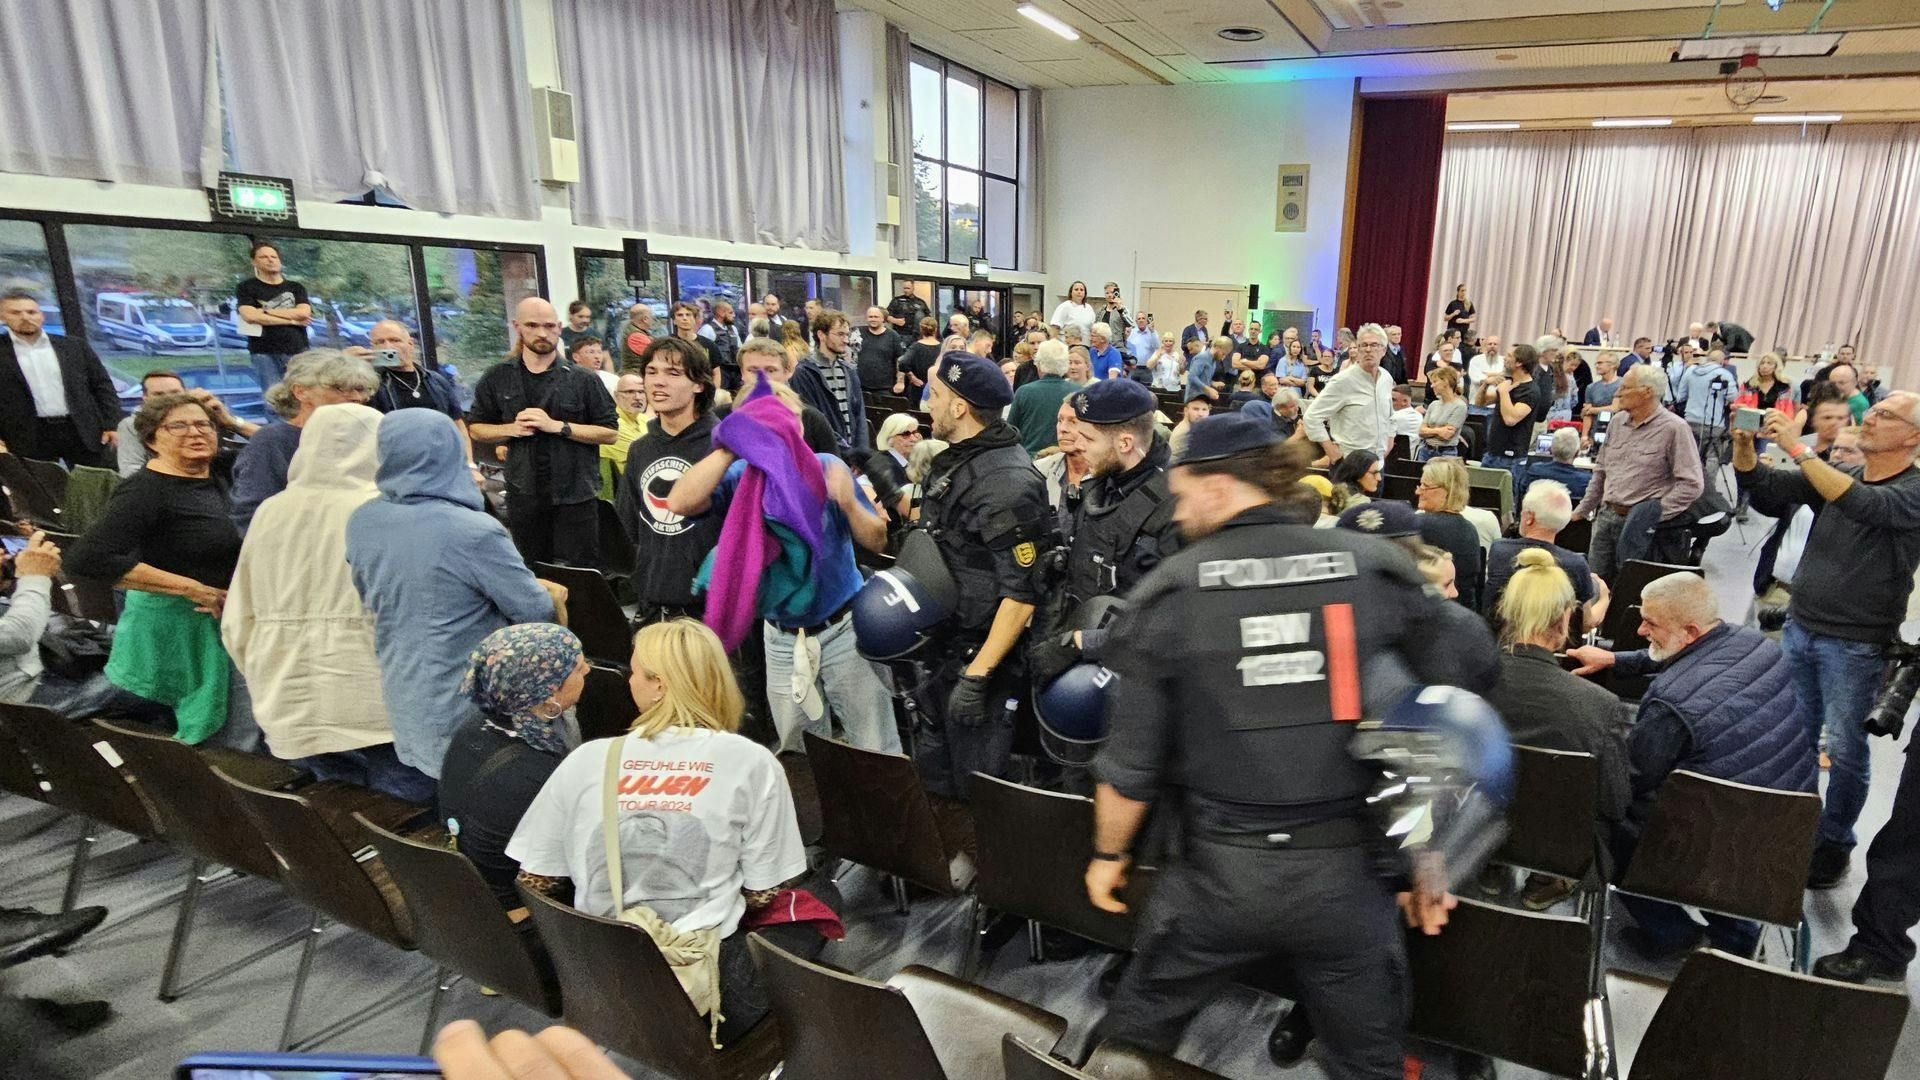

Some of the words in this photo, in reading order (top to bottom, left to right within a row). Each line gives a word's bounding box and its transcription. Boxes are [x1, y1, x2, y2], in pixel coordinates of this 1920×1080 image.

[640, 459, 690, 491] ANTIFASCHIST
[652, 521, 683, 533] AKTION
[1240, 612, 1311, 648] BW
[688, 761, 714, 773] WIE
[616, 775, 711, 796] LILIEN
[619, 800, 656, 811] TOUR
[658, 801, 692, 812] 2024
